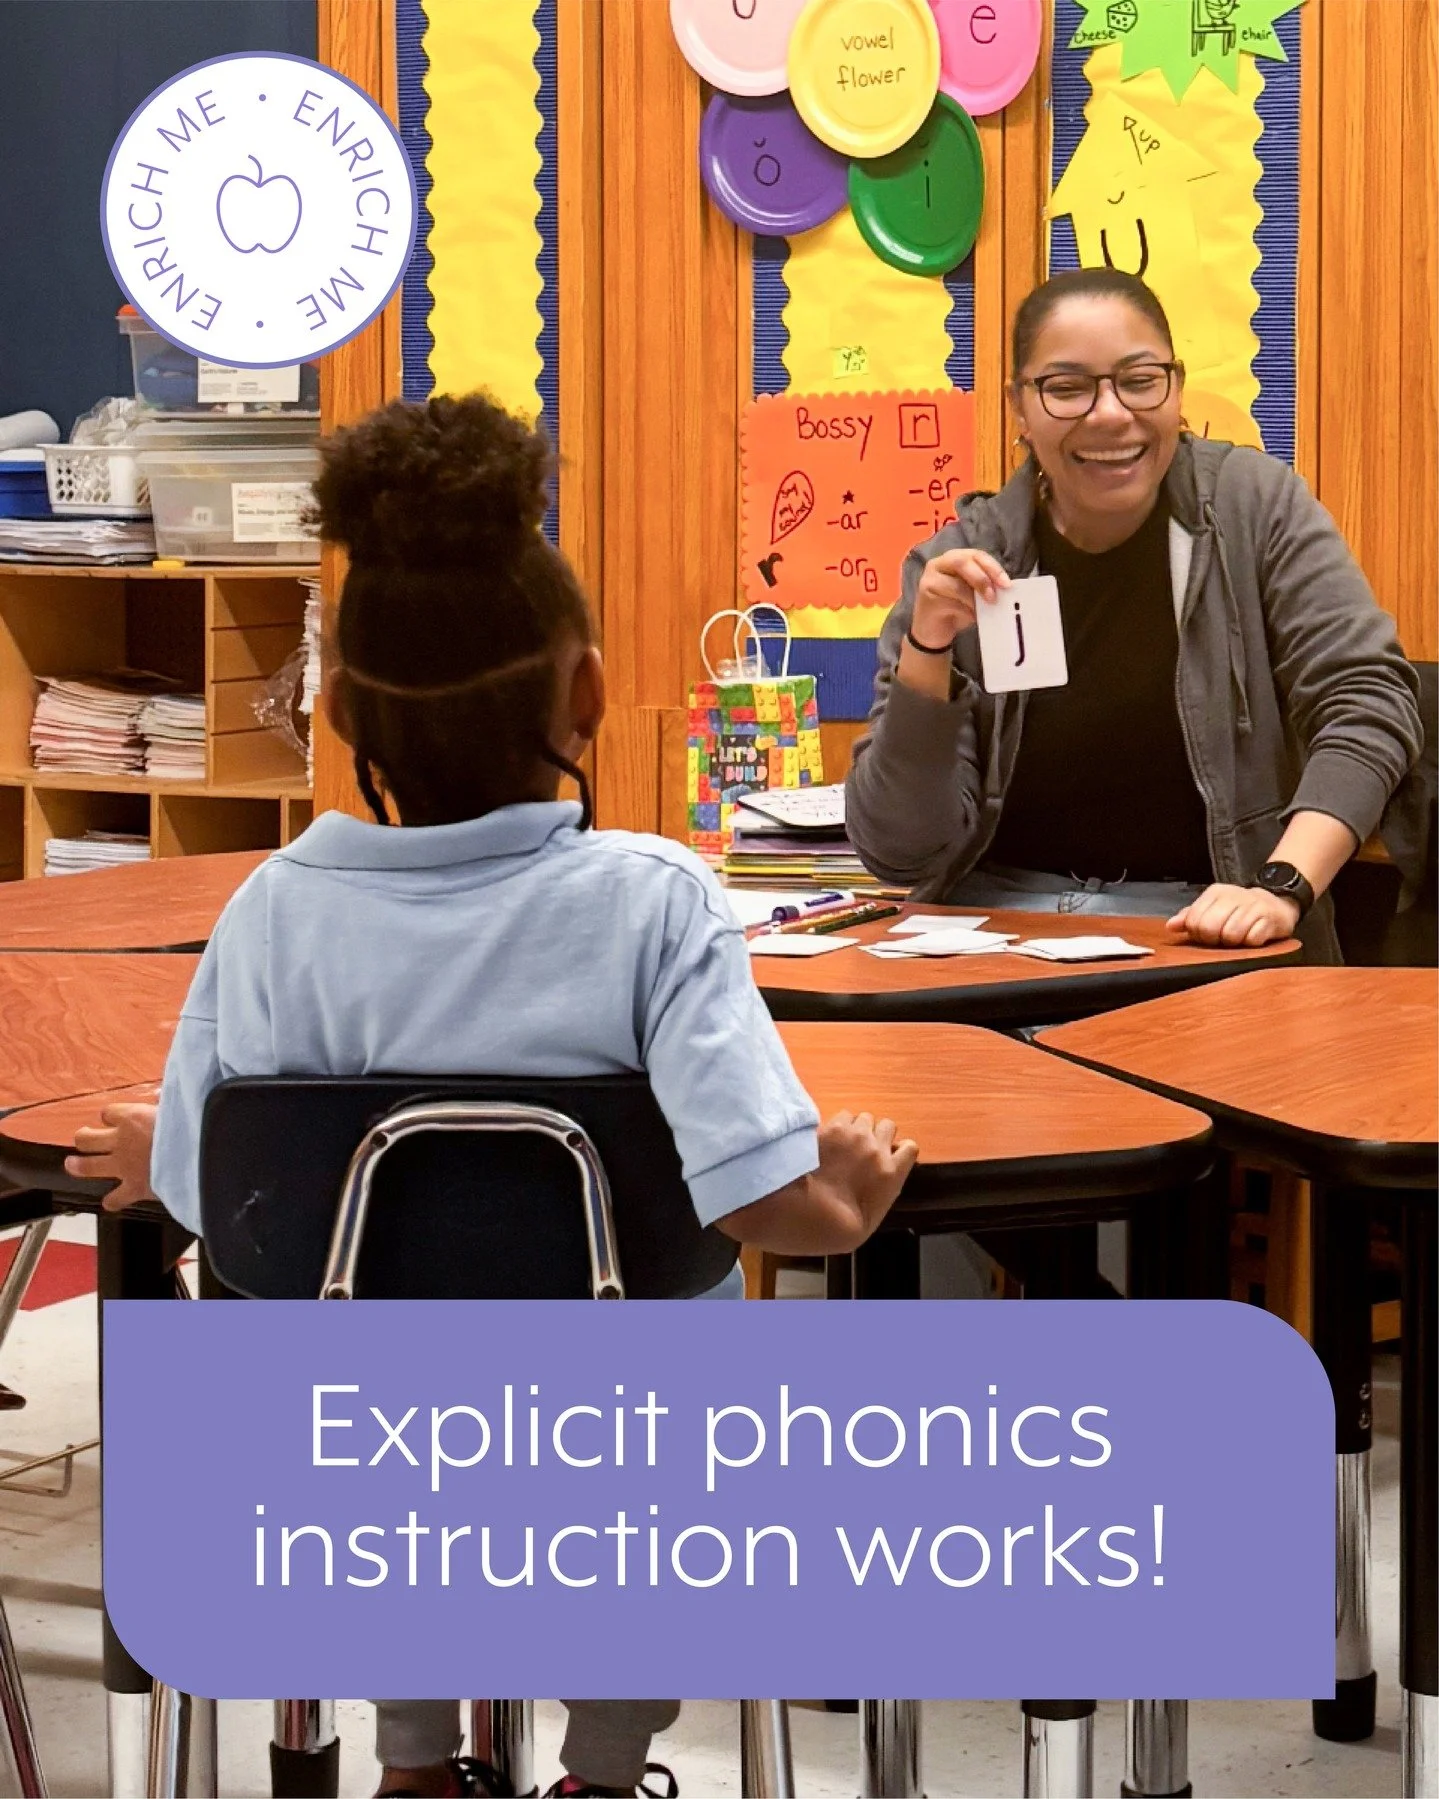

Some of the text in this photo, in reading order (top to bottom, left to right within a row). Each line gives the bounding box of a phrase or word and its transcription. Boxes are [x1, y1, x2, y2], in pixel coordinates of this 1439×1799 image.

[969, 5, 997, 44] e
[1074, 29, 1117, 44] cheese
[1241, 26, 1272, 41] chair
[841, 27, 894, 51] vowel
[836, 65, 906, 92] flower
[1139, 129, 1161, 155] up
[796, 406, 931, 462] Bossy r
[1014, 602, 1026, 667] j
[718, 745, 758, 763] LET'S
[724, 765, 768, 783] BUILD
